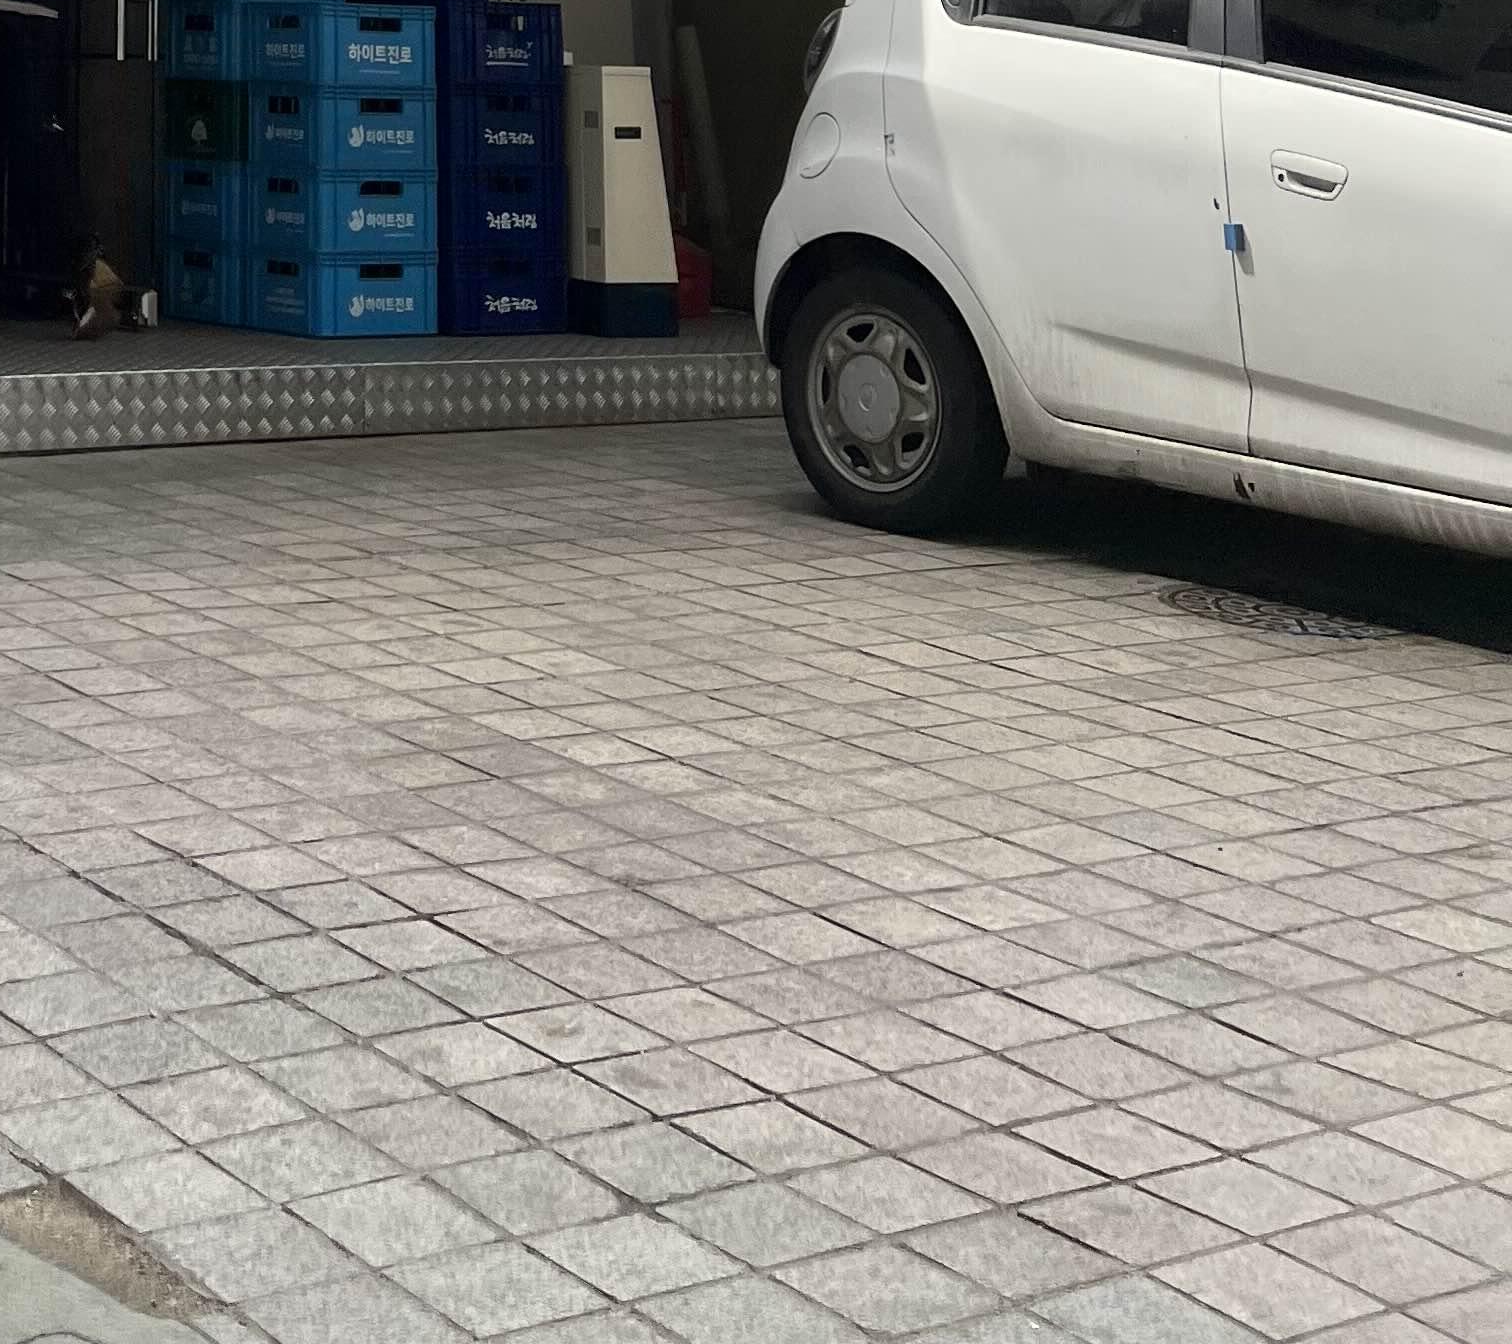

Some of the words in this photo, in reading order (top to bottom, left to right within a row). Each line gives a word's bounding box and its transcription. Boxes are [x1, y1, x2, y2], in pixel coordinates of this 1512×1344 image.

[348, 43, 412, 65] 하이트진로
[365, 128, 415, 146] 하이트진로
[365, 211, 415, 229] 하이트진로
[486, 211, 538, 230] 처음처럼
[364, 296, 415, 313] 하이트진로
